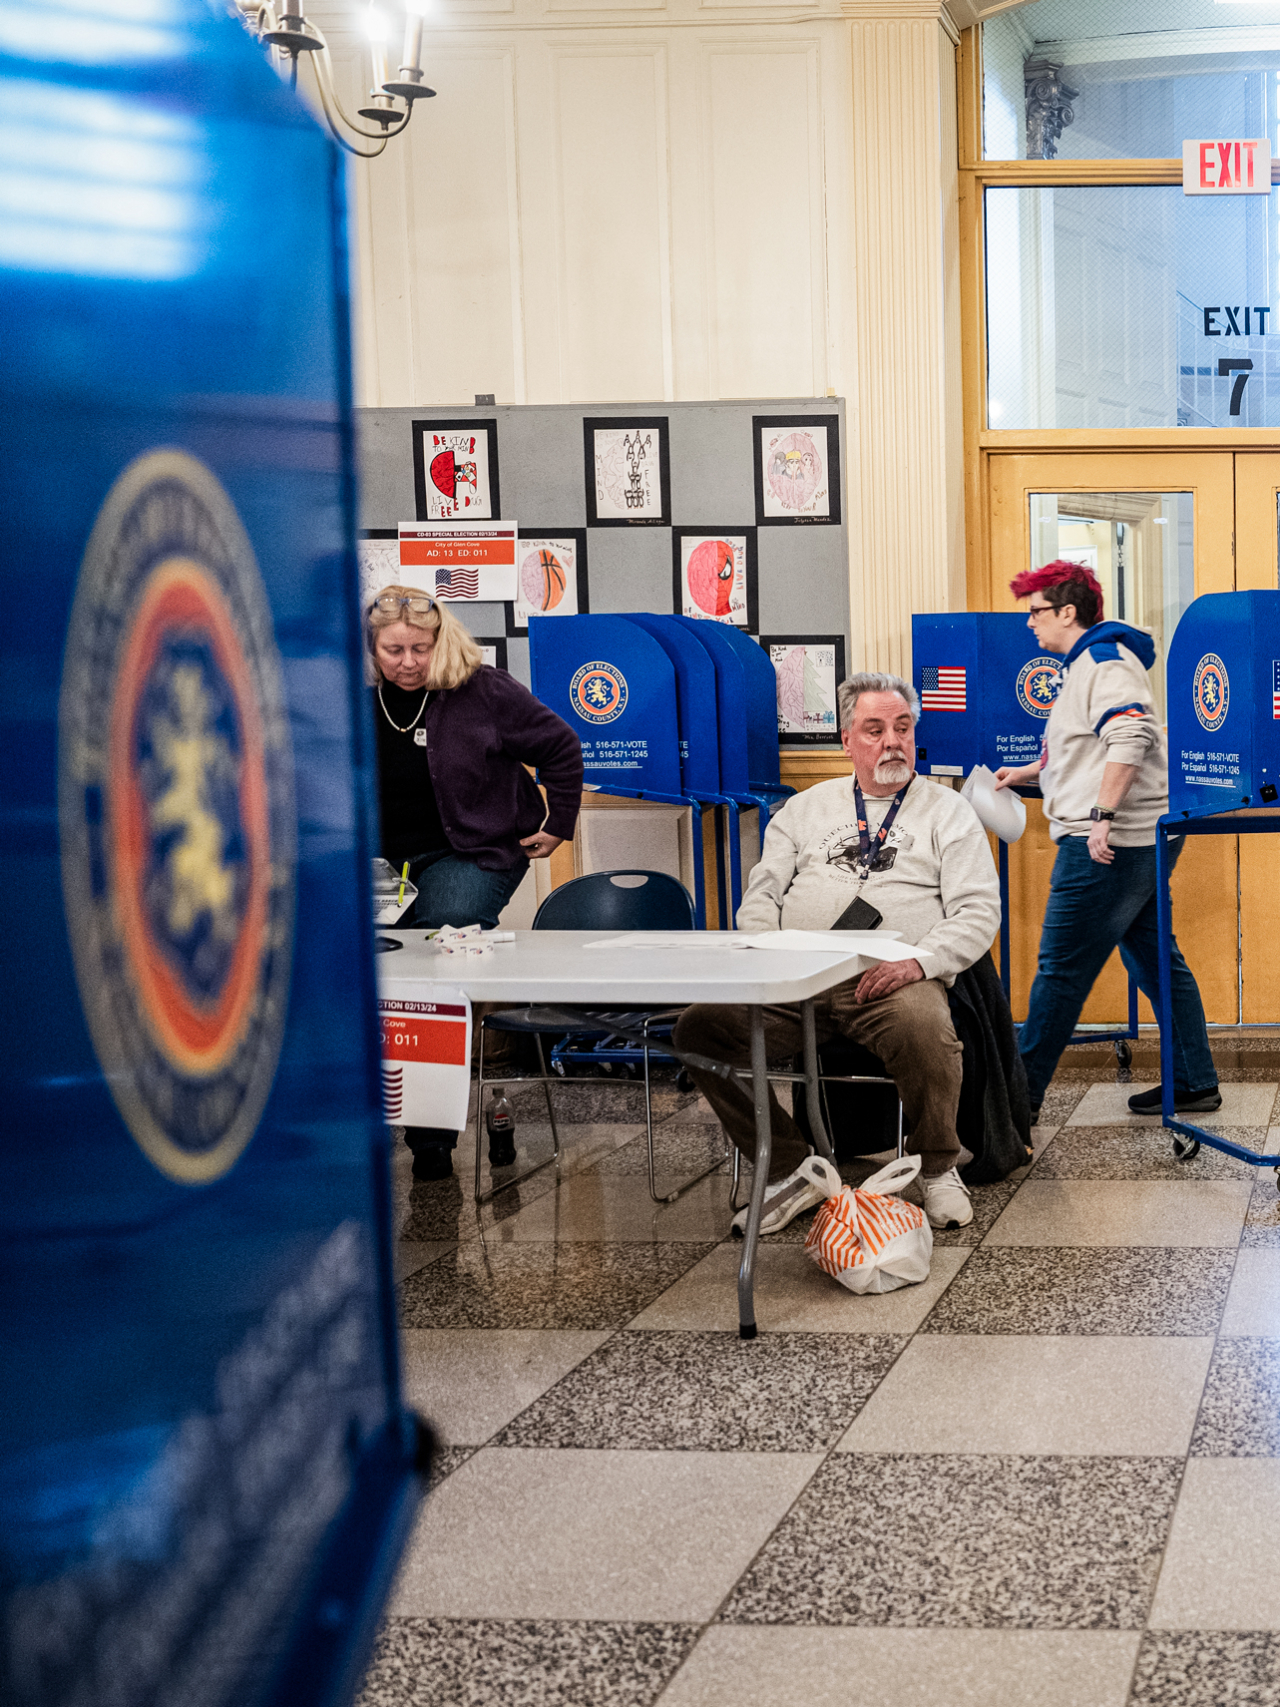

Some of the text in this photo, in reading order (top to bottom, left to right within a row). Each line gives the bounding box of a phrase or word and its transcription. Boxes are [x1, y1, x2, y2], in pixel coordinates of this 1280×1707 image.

[1199, 142, 1259, 188] EXIT
[1204, 307, 1270, 336] EXIT
[1218, 358, 1254, 416] 7
[433, 435, 475, 448] BE KIND
[432, 496, 482, 511] LIVE DRUG
[431, 506, 452, 517] FREE
[573, 668, 586, 689] BOARD
[596, 663, 624, 688] ELECTIONS
[1019, 664, 1032, 685] BOARD
[1042, 659, 1062, 670] ELECT
[573, 697, 592, 719] NASSAU
[1019, 693, 1037, 715] NASSAU
[1010, 735, 1035, 744] English
[1010, 744, 1038, 753] Español
[1189, 750, 1205, 761] English
[1207, 752, 1239, 763] 516-571-VOTE
[1190, 762, 1206, 772] Español
[1209, 764, 1240, 775] 516-571-1245
[378, 1001, 437, 1012] CTION 02/13/24
[383, 1018, 406, 1028] Cove
[380, 1032, 418, 1046] D: 011
